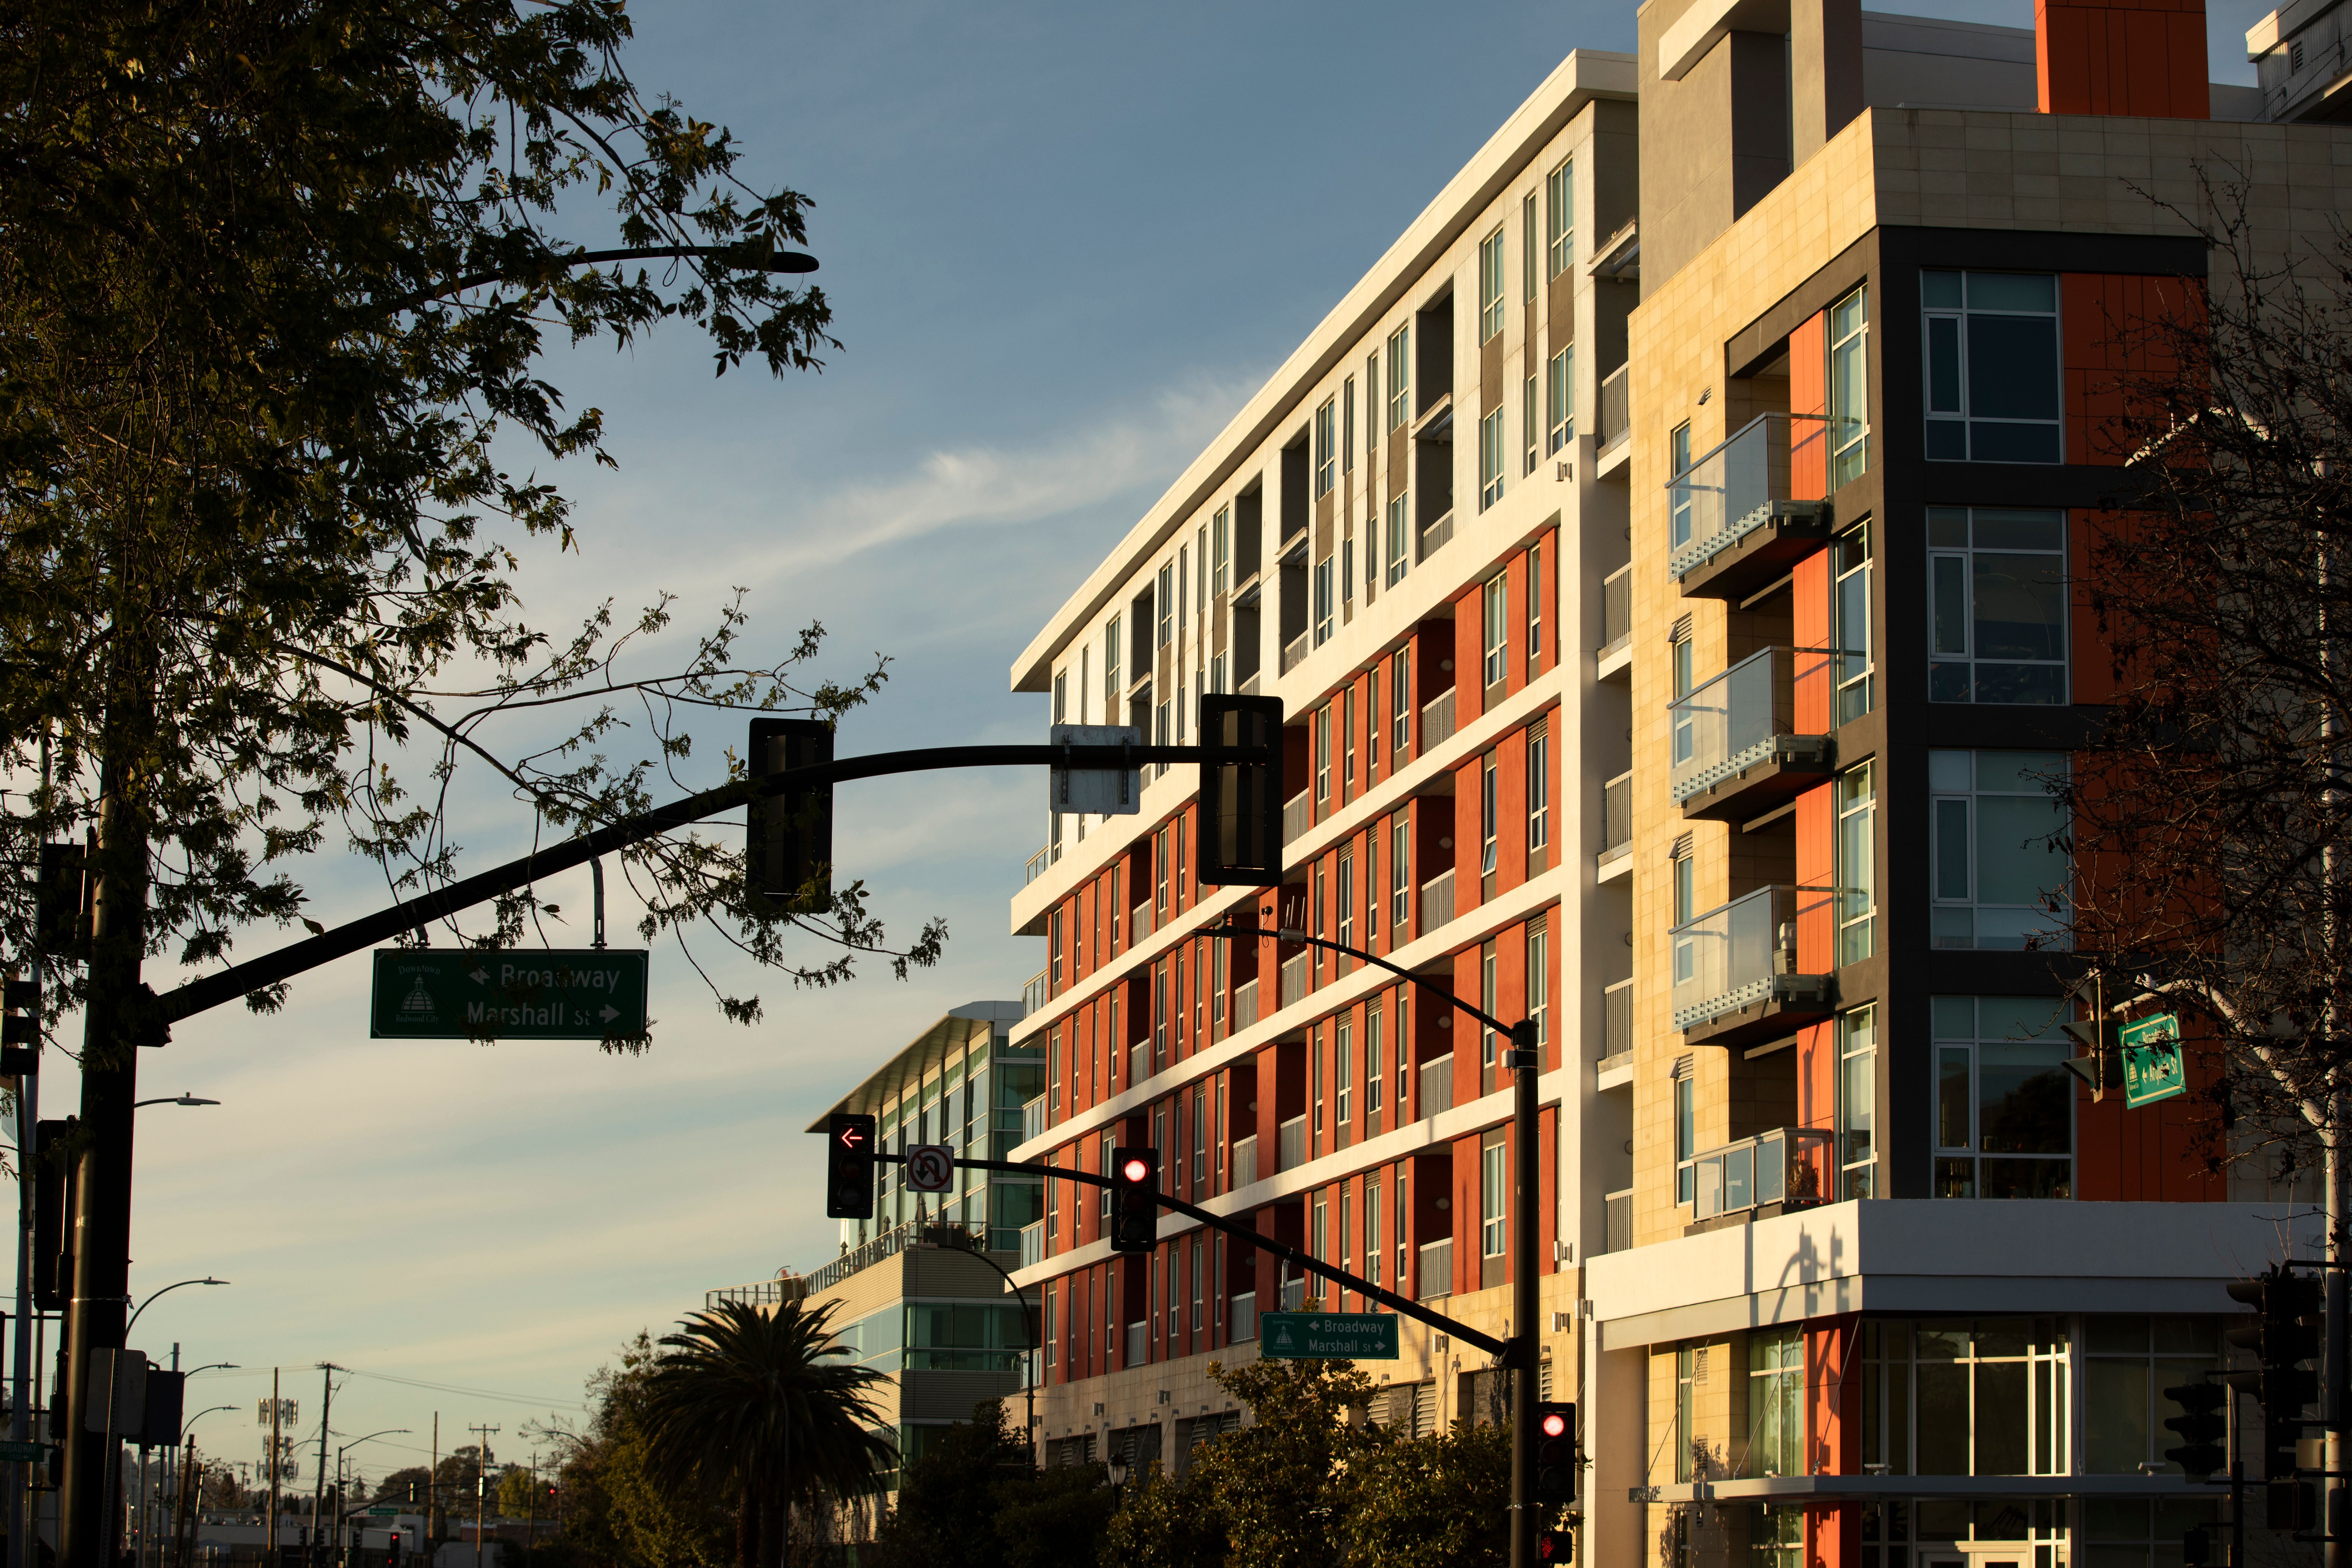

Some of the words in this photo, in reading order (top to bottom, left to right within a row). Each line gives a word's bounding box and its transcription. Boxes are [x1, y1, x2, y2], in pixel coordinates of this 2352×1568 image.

[398, 964, 441, 975] Downtown
[395, 1014, 424, 1022] Redwood
[426, 1014, 440, 1025] City
[467, 1002, 563, 1025] Marshall
[574, 1009, 590, 1026] St
[2171, 1056, 2179, 1075] St
[1325, 1320, 1384, 1335] Broadway
[1309, 1339, 1357, 1352] Marshall
[1363, 1344, 1371, 1352] St
[0, 1443, 37, 1453] BROADWAY
